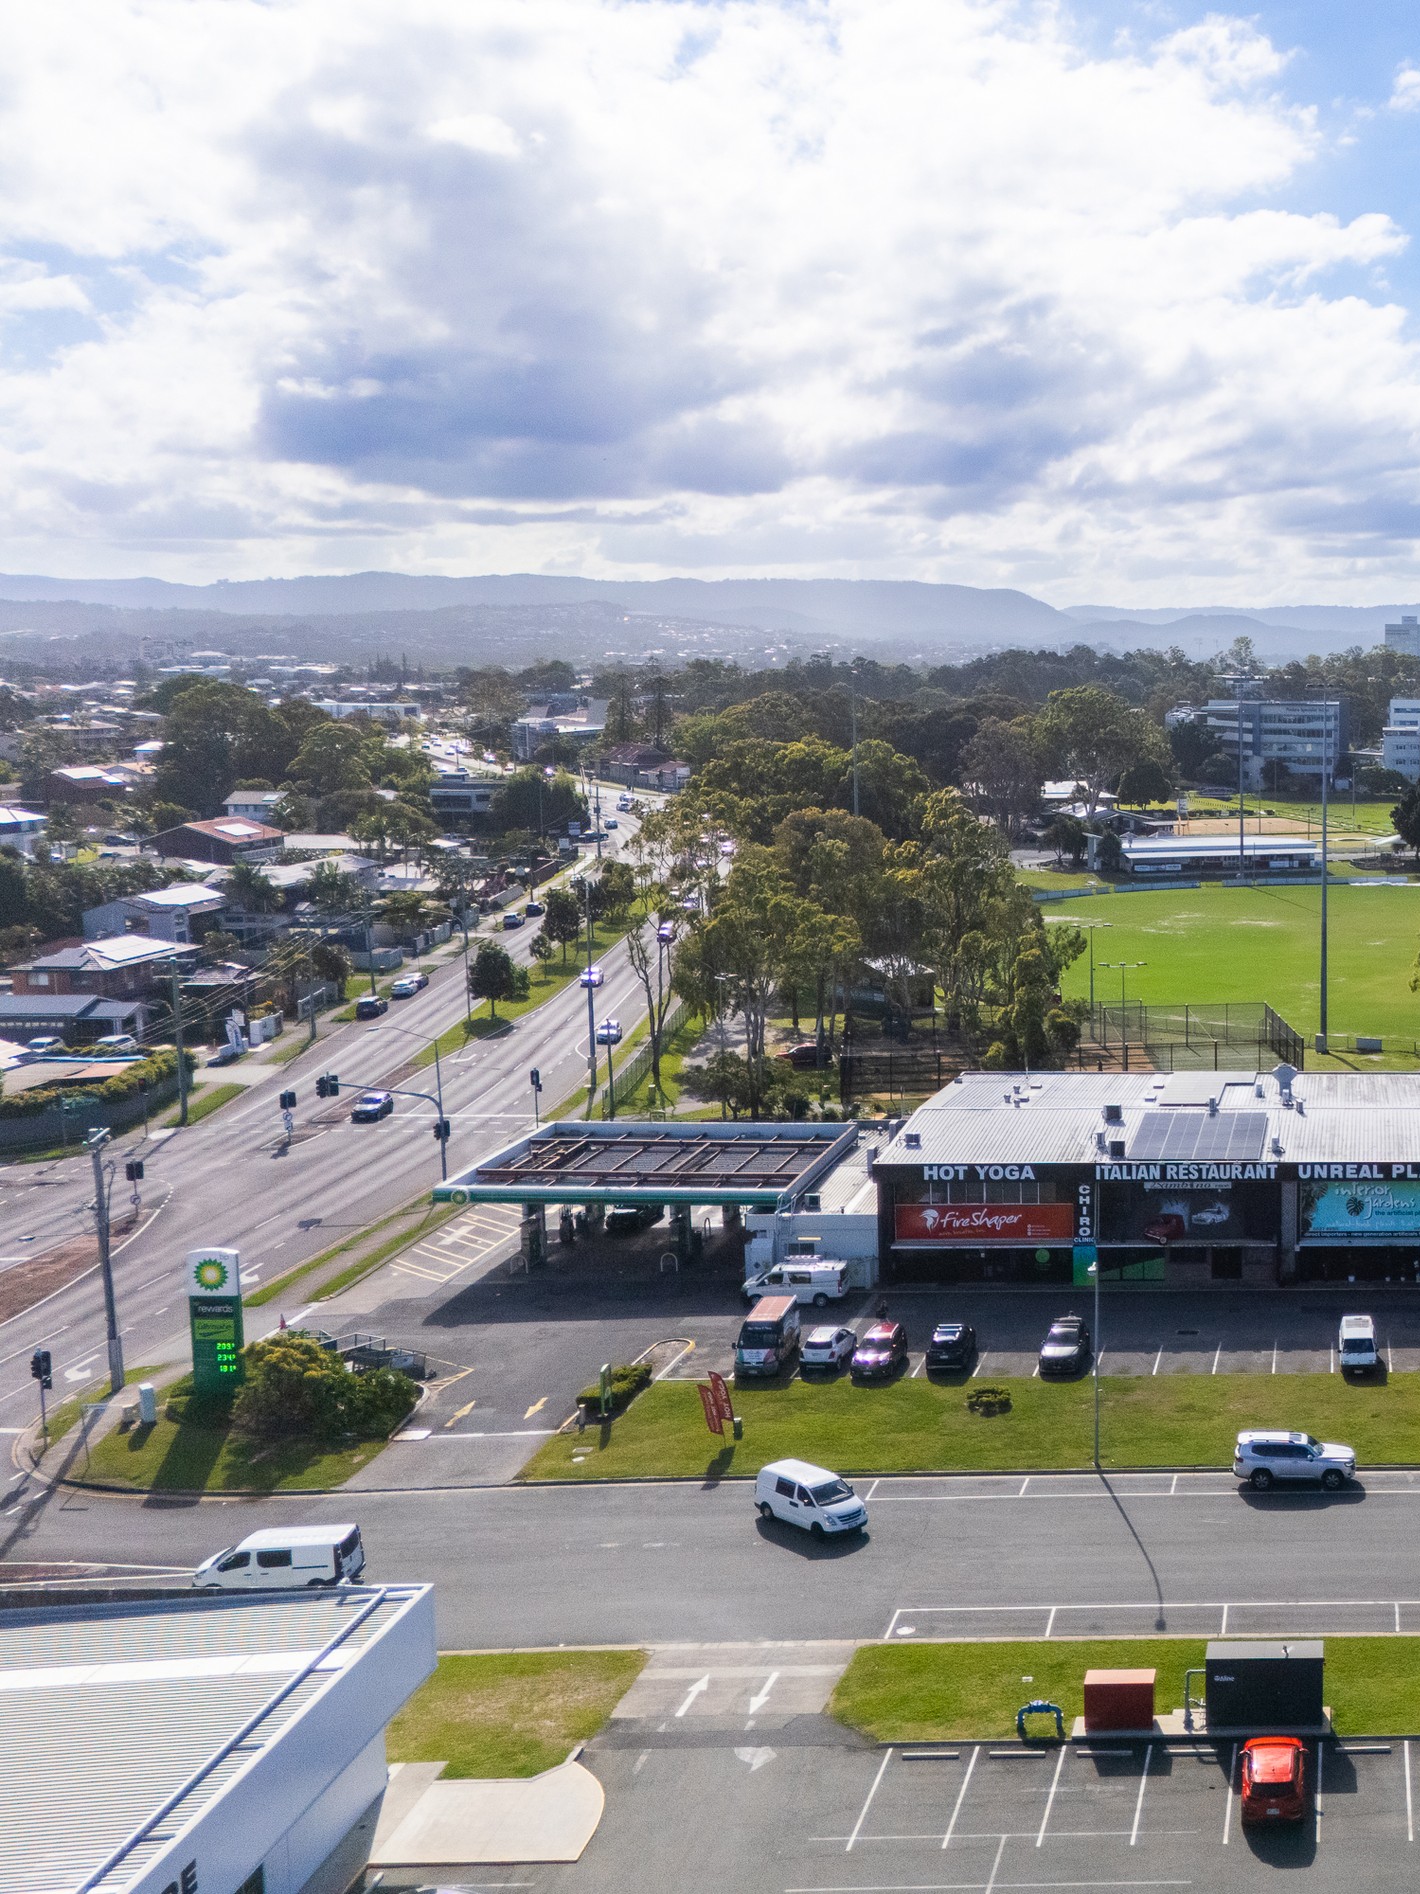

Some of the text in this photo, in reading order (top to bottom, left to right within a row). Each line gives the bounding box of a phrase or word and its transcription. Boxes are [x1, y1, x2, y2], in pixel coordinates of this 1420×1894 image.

[923, 1165, 1035, 1181] HOT YOGA
[1096, 1164, 1277, 1180] ITALIAN RESTAURANT
[1298, 1164, 1383, 1179] UNREAL
[1334, 1181, 1391, 1195] interior
[1078, 1185, 1091, 1236] CHIRO
[1364, 1191, 1416, 1220] gardens
[219, 1253, 229, 1261] bp
[198, 1304, 234, 1313] rewards
[717, 1380, 731, 1418] HOT YOGA
